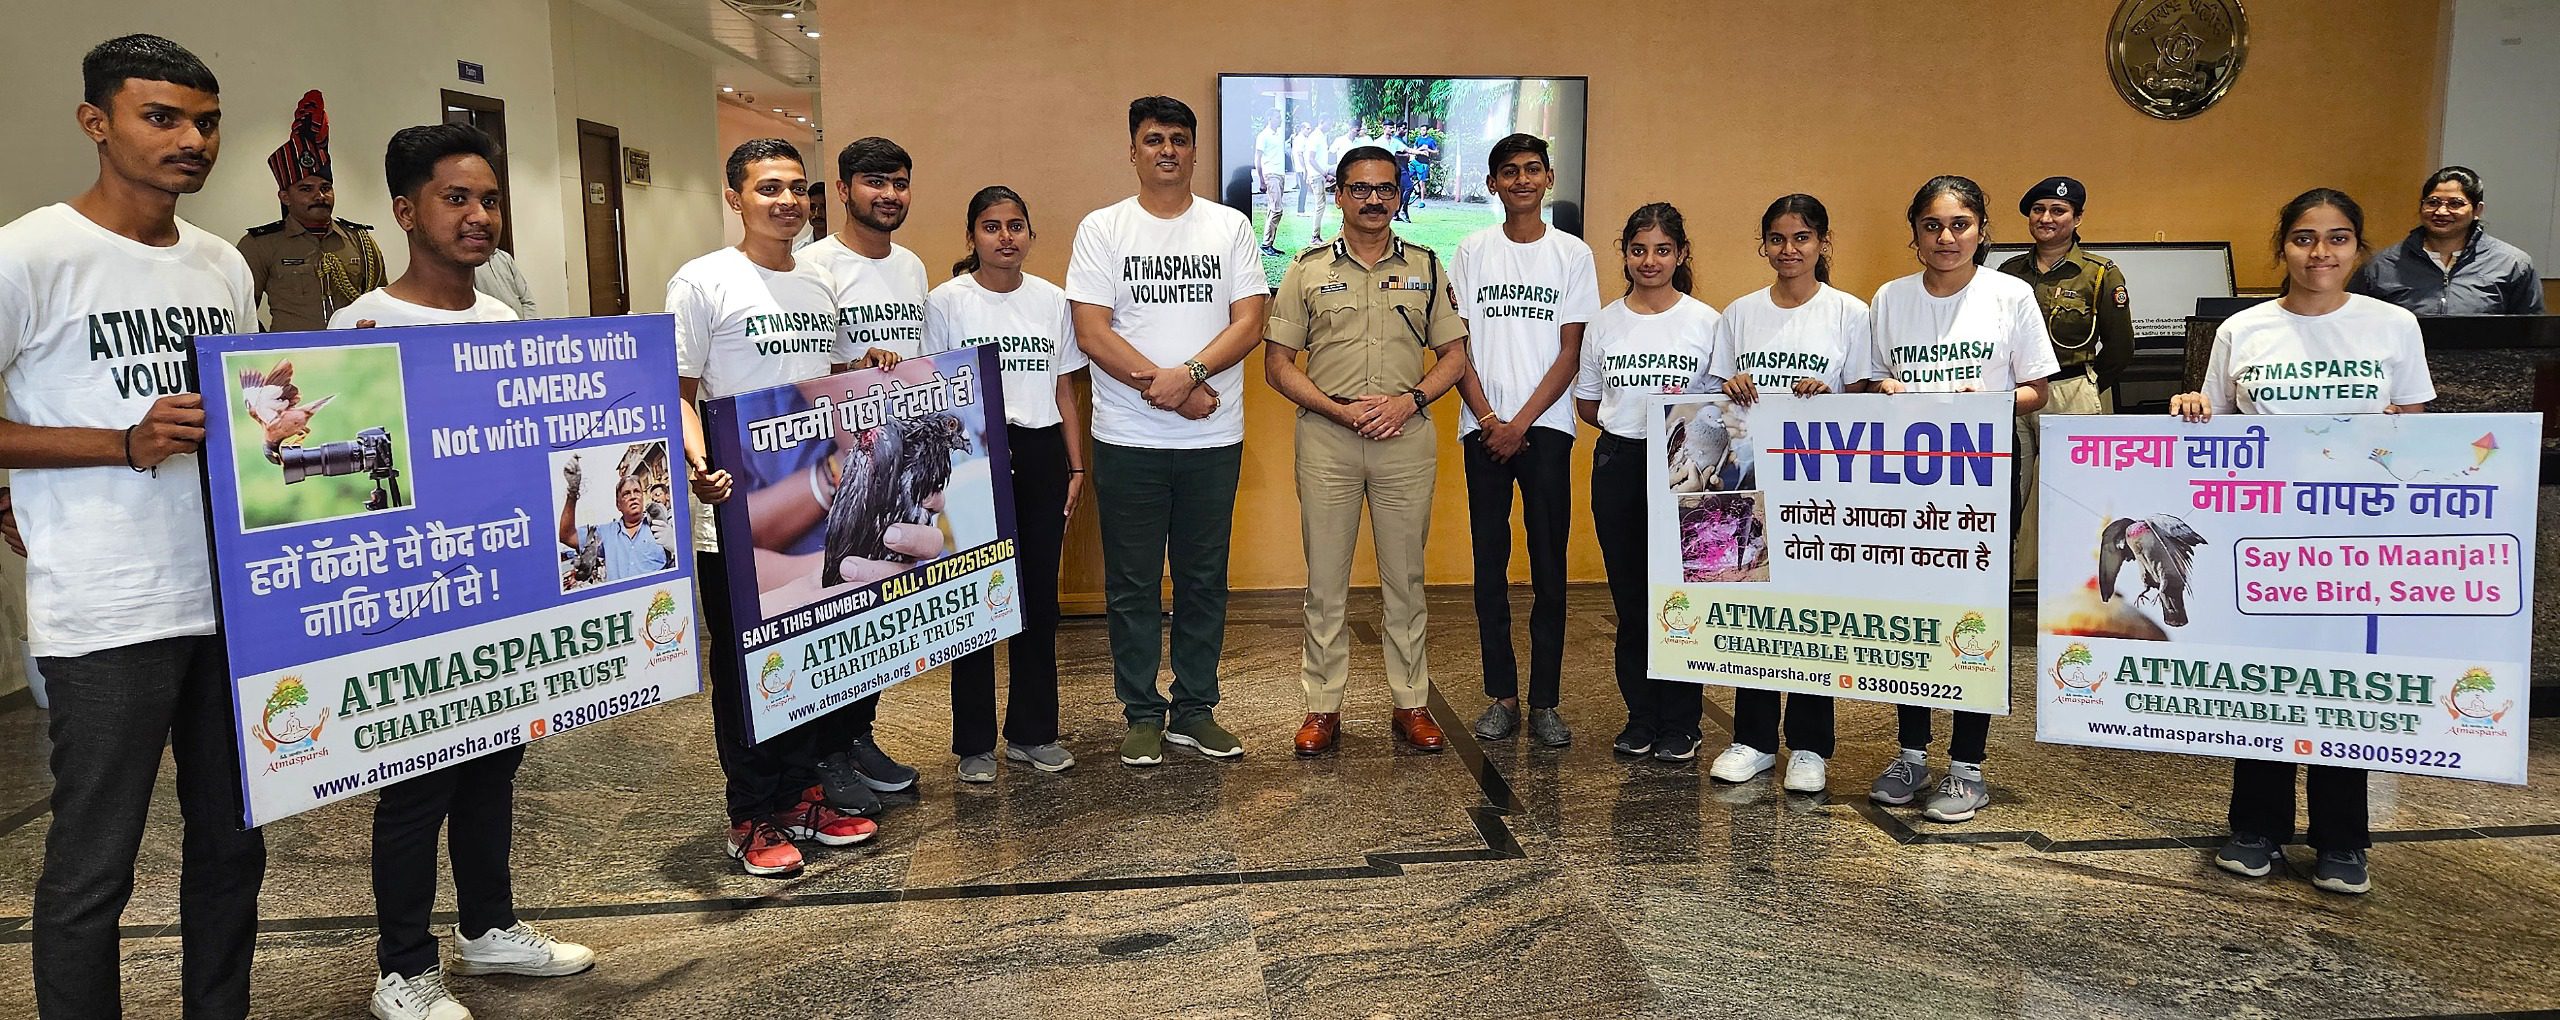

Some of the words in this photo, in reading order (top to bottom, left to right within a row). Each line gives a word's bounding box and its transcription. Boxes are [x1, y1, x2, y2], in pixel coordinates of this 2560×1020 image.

[1123, 254, 1221, 281] ATMASPARSH
[838, 303, 925, 326] ATMASPARS
[1131, 283, 1214, 303] VOLUNTEER
[88, 306, 236, 362] ATMASPARS
[745, 312, 835, 337] ATMASPARS
[848, 327, 922, 343] VOLUNTEE
[453, 339, 517, 373] Hunt
[521, 334, 584, 367] Birds
[588, 331, 637, 362] with
[756, 339, 835, 356] VOLUNTEE
[1736, 351, 1829, 374] ATMASPARSH
[1890, 341, 1994, 366] ATMASPARSH
[497, 371, 607, 408] CAMERAS
[838, 384, 889, 433] पंछी
[888, 371, 949, 419] देखते
[950, 365, 975, 407] ही
[2248, 384, 2379, 402] VOLUNTEER
[432, 425, 480, 459] Not
[484, 417, 540, 452] with
[544, 407, 645, 444] THREADS
[651, 404, 667, 431] !!
[2067, 434, 2178, 472] माझ्या
[2184, 425, 2270, 469] साठी
[1783, 421, 1994, 487] NYLON
[1779, 499, 1837, 527] मांजेसे
[1842, 506, 1907, 529] आपका
[1912, 501, 1952, 532] और
[1957, 503, 1996, 533] मेरा
[2189, 471, 2287, 514] मांजा
[2293, 482, 2400, 517] वापरू
[2406, 483, 2499, 519] नका
[245, 545, 304, 597] हमें
[393, 526, 424, 569] से
[426, 520, 475, 562] कैद
[479, 507, 530, 553] करो
[1784, 534, 1825, 561] दोनो
[1829, 542, 1857, 565] का
[1862, 544, 1905, 566] गला
[1910, 545, 1972, 570] कटता
[1974, 541, 1992, 572] है
[2244, 546, 2290, 573] Say
[2299, 546, 2333, 567] No
[2339, 545, 2370, 567] To
[2378, 543, 2511, 571] Maanja!!
[300, 586, 382, 638] नाकि
[454, 564, 484, 607] से
[490, 568, 500, 601] !
[742, 621, 780, 649] SAVE
[781, 610, 813, 635] THIS
[814, 590, 870, 623] NUMBER
[926, 538, 1015, 587] 07122515306
[2246, 582, 2310, 603] Save
[2316, 581, 2381, 606] Bird,
[2389, 581, 2457, 603] Save
[2464, 581, 2501, 603] Us
[801, 581, 980, 672] ATMASPARSH
[1705, 602, 1942, 645] ATMASPARSH
[338, 610, 635, 719] ATMASPARSH
[811, 634, 920, 690] CHARITABLE
[924, 611, 976, 645] TRUST
[1713, 634, 1848, 662] CHARITABLE
[1854, 646, 1930, 670] TRUST
[788, 662, 911, 722] www.atmasparsha.org
[929, 628, 999, 667] 8380059222
[1686, 658, 1832, 687] www.atmasparsha.org
[1858, 676, 1963, 701] 8380059222
[2114, 655, 2434, 705] ATMASPARSH
[354, 680, 537, 752] CHARITABLE
[544, 656, 627, 698] TRUST
[2124, 692, 2306, 726] CHARITABLE
[2315, 707, 2421, 733] TRUST
[262, 746, 329, 777] Atmasparsh
[313, 724, 522, 800] www.atmasparsha.org
[552, 684, 661, 733] 8380059222
[2088, 720, 2285, 753] www.atmasparsha.org
[2320, 741, 2462, 769] 8380059222
